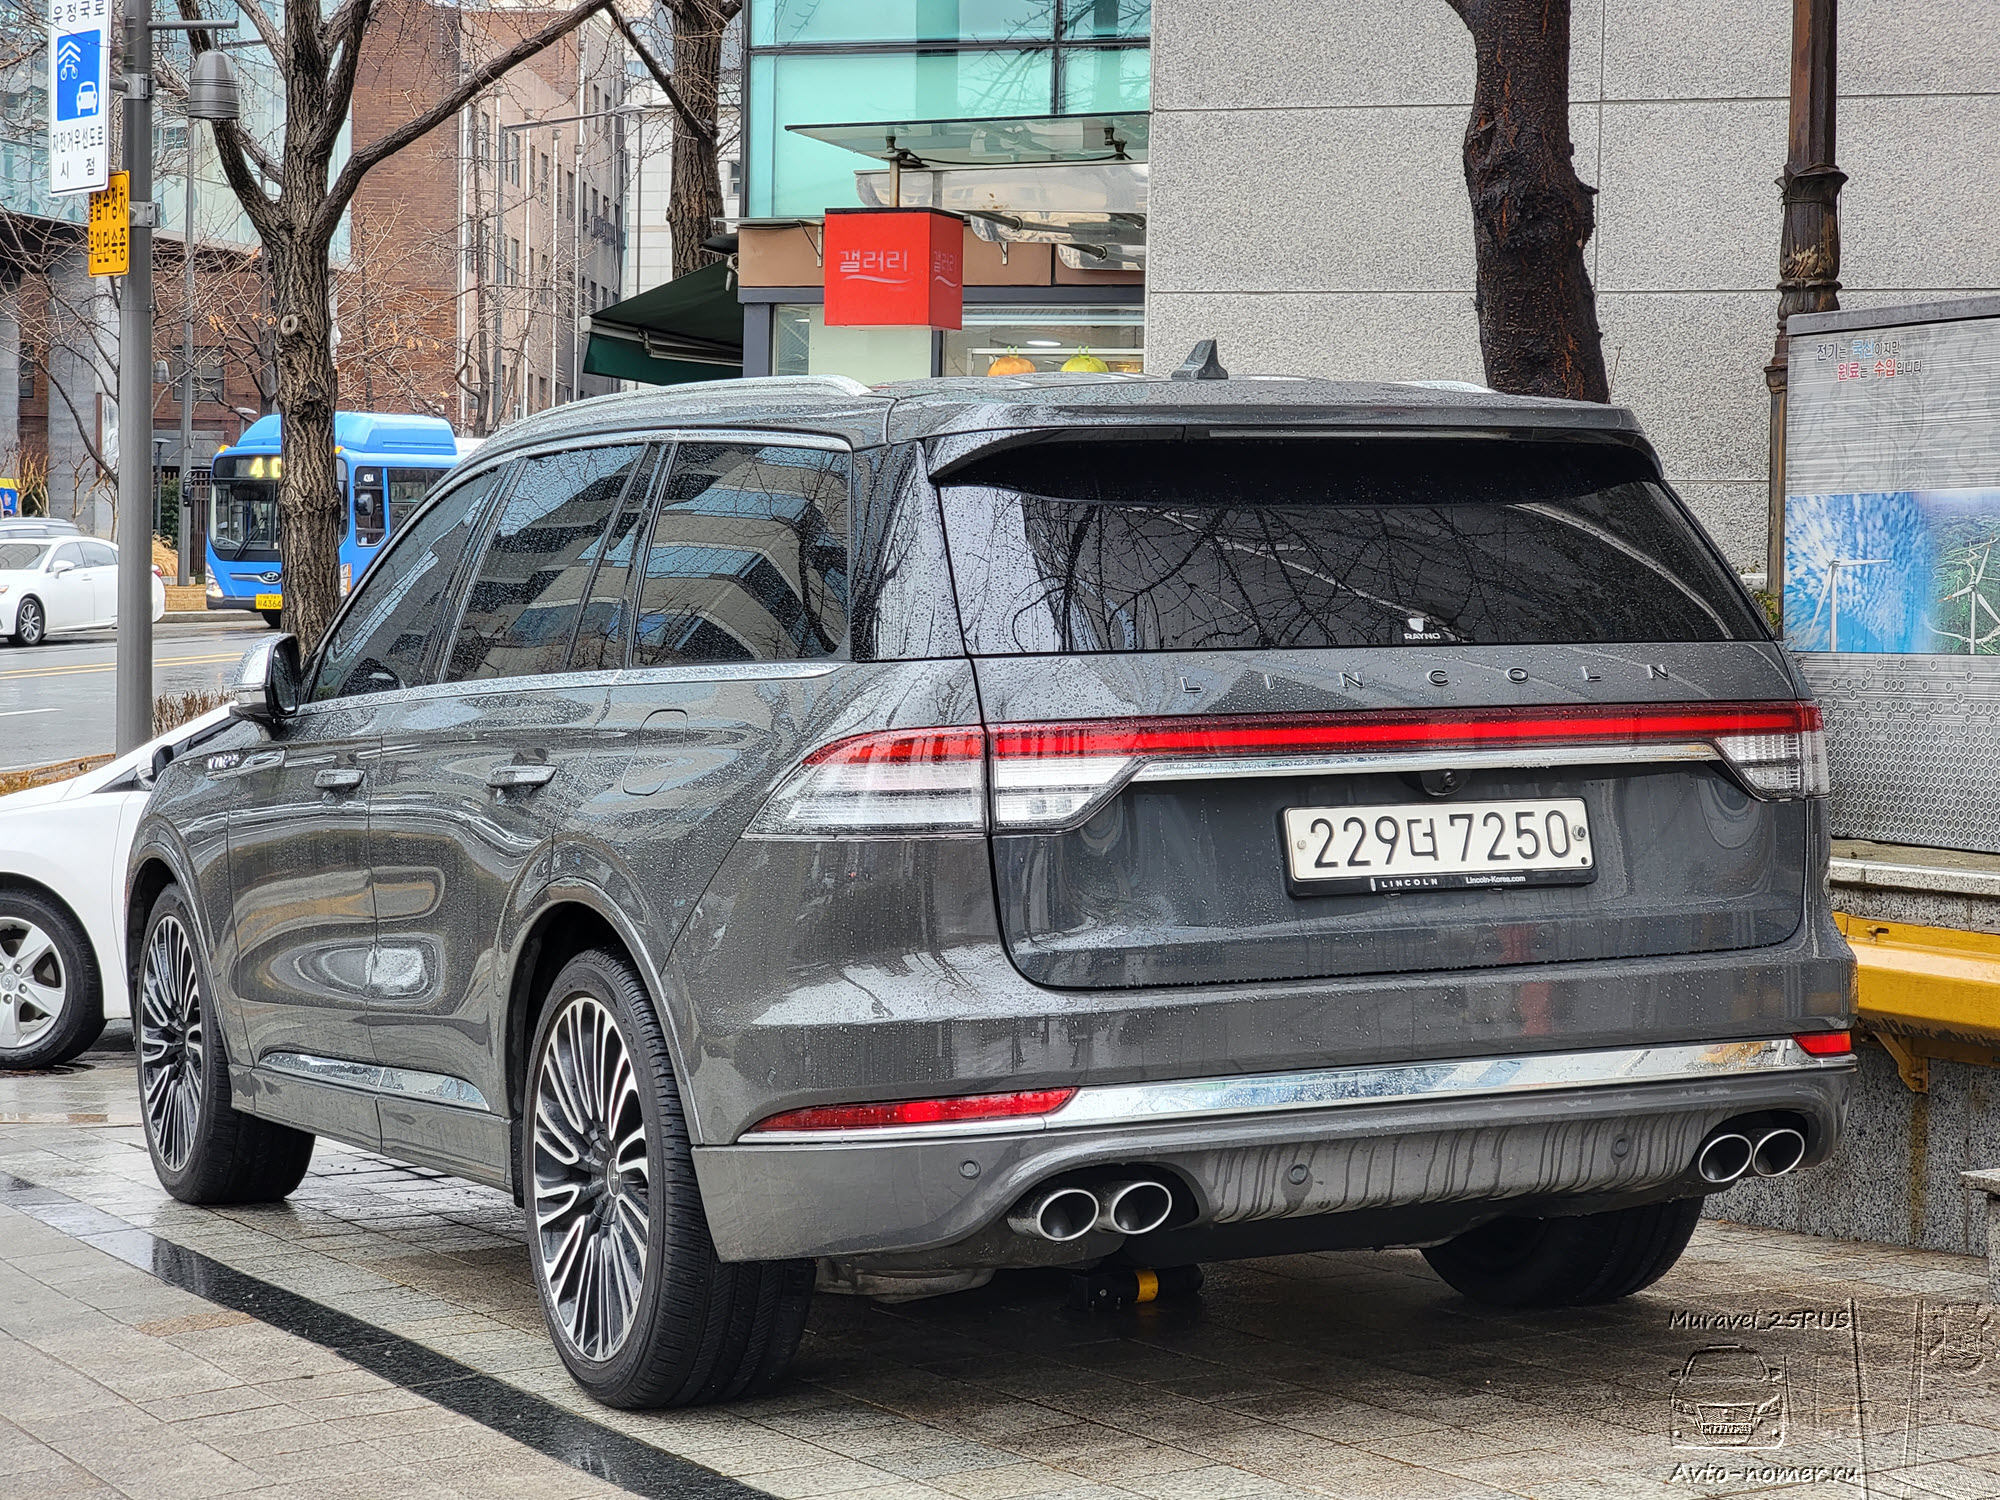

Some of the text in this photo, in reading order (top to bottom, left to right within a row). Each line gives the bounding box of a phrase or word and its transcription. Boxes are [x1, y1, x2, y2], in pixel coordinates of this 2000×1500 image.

[53, 0, 105, 25] 우정국로
[53, 126, 104, 154] 자전거우선도로
[840, 250, 908, 272] 갤러리
[1817, 340, 1900, 361] 전기는 국산이지만
[1838, 359, 1922, 380] 원료는 수입입니다
[1404, 632, 1441, 640] RAYNO
[1181, 663, 1670, 694] LINCOLN
[1448, 809, 1571, 863] 7250
[1381, 875, 1526, 889] LINCOLN Lincoln-Korea.com
